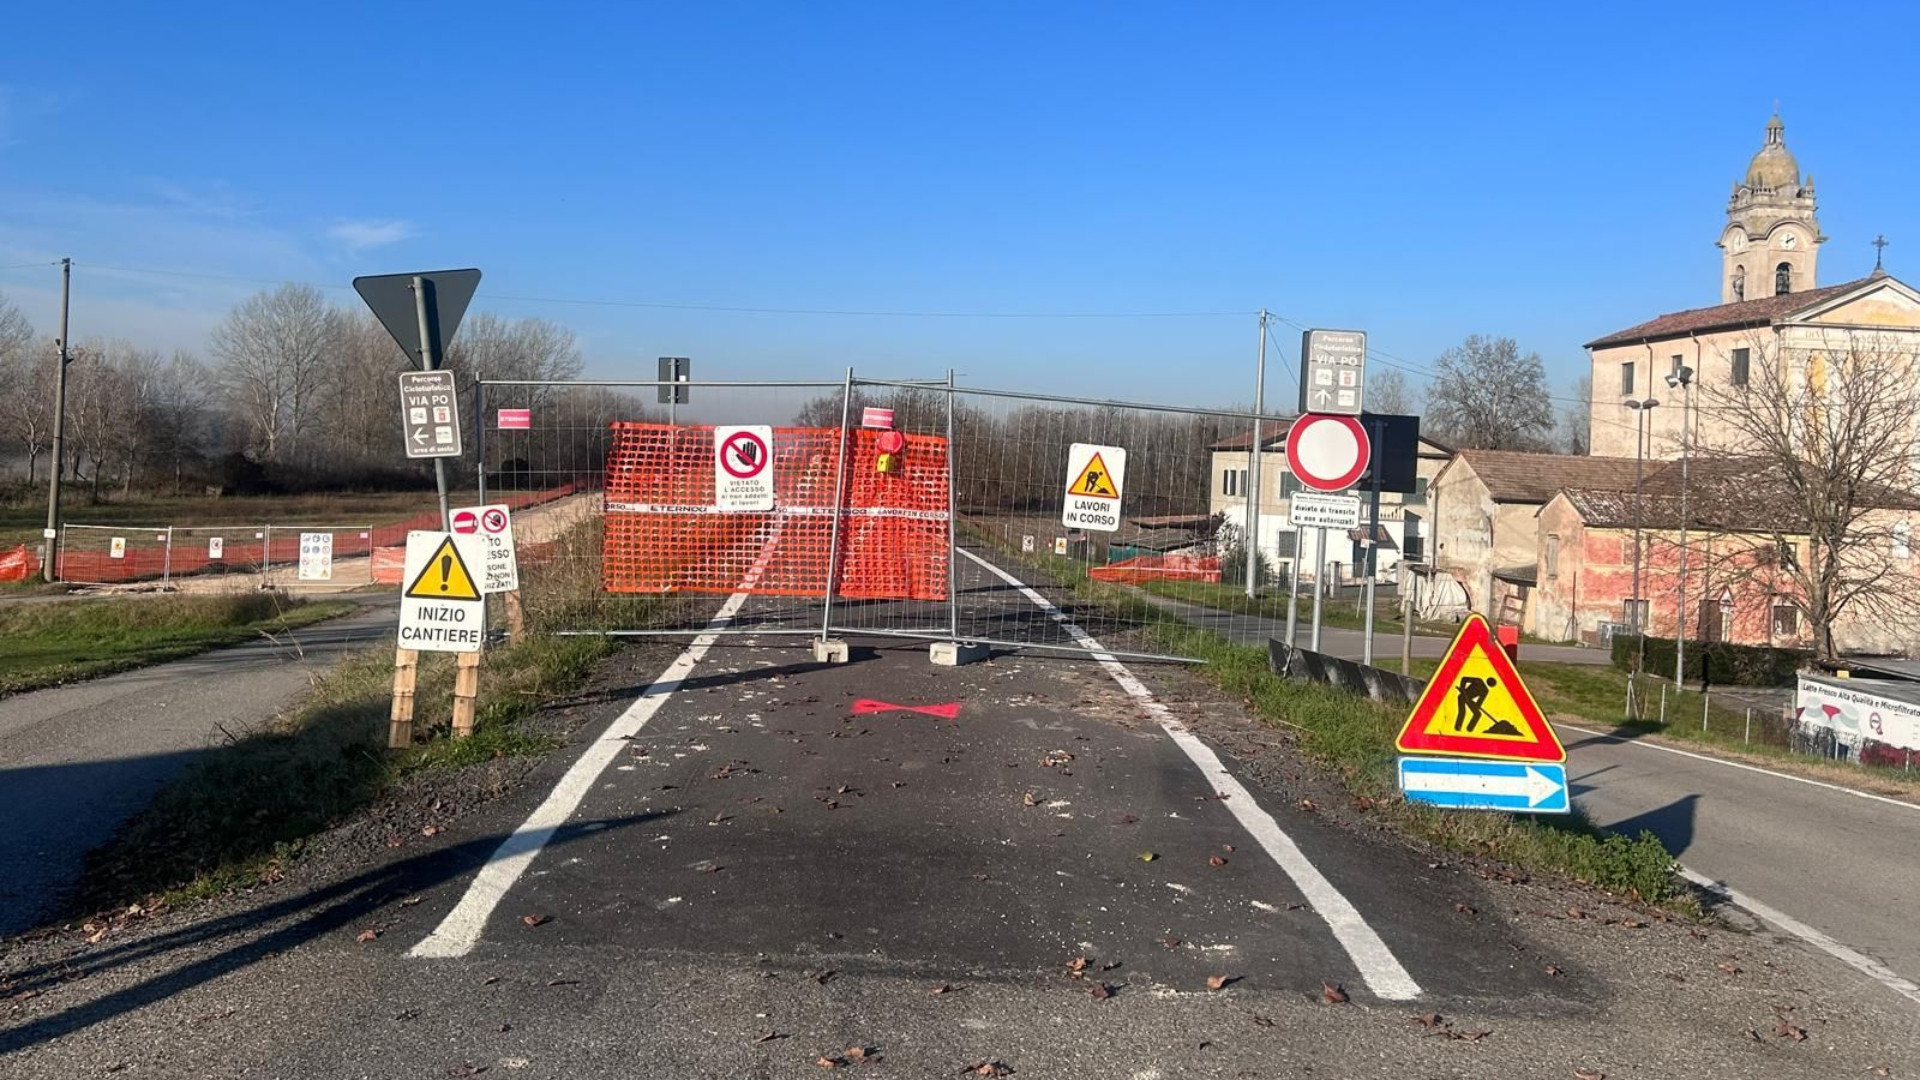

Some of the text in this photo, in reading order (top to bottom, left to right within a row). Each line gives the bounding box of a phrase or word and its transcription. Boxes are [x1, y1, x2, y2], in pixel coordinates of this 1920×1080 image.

[1316, 354, 1358, 366] VIA PO
[408, 394, 449, 406] VIA PO
[1074, 500, 1110, 512] LAVORI
[1067, 512, 1116, 526] IN CORSO
[418, 606, 466, 623] INIZIO
[401, 626, 479, 643] CANTIERE
[1803, 682, 1818, 693] Latte
[1818, 686, 1838, 698] Fresco
[1838, 691, 1851, 701] Alta
